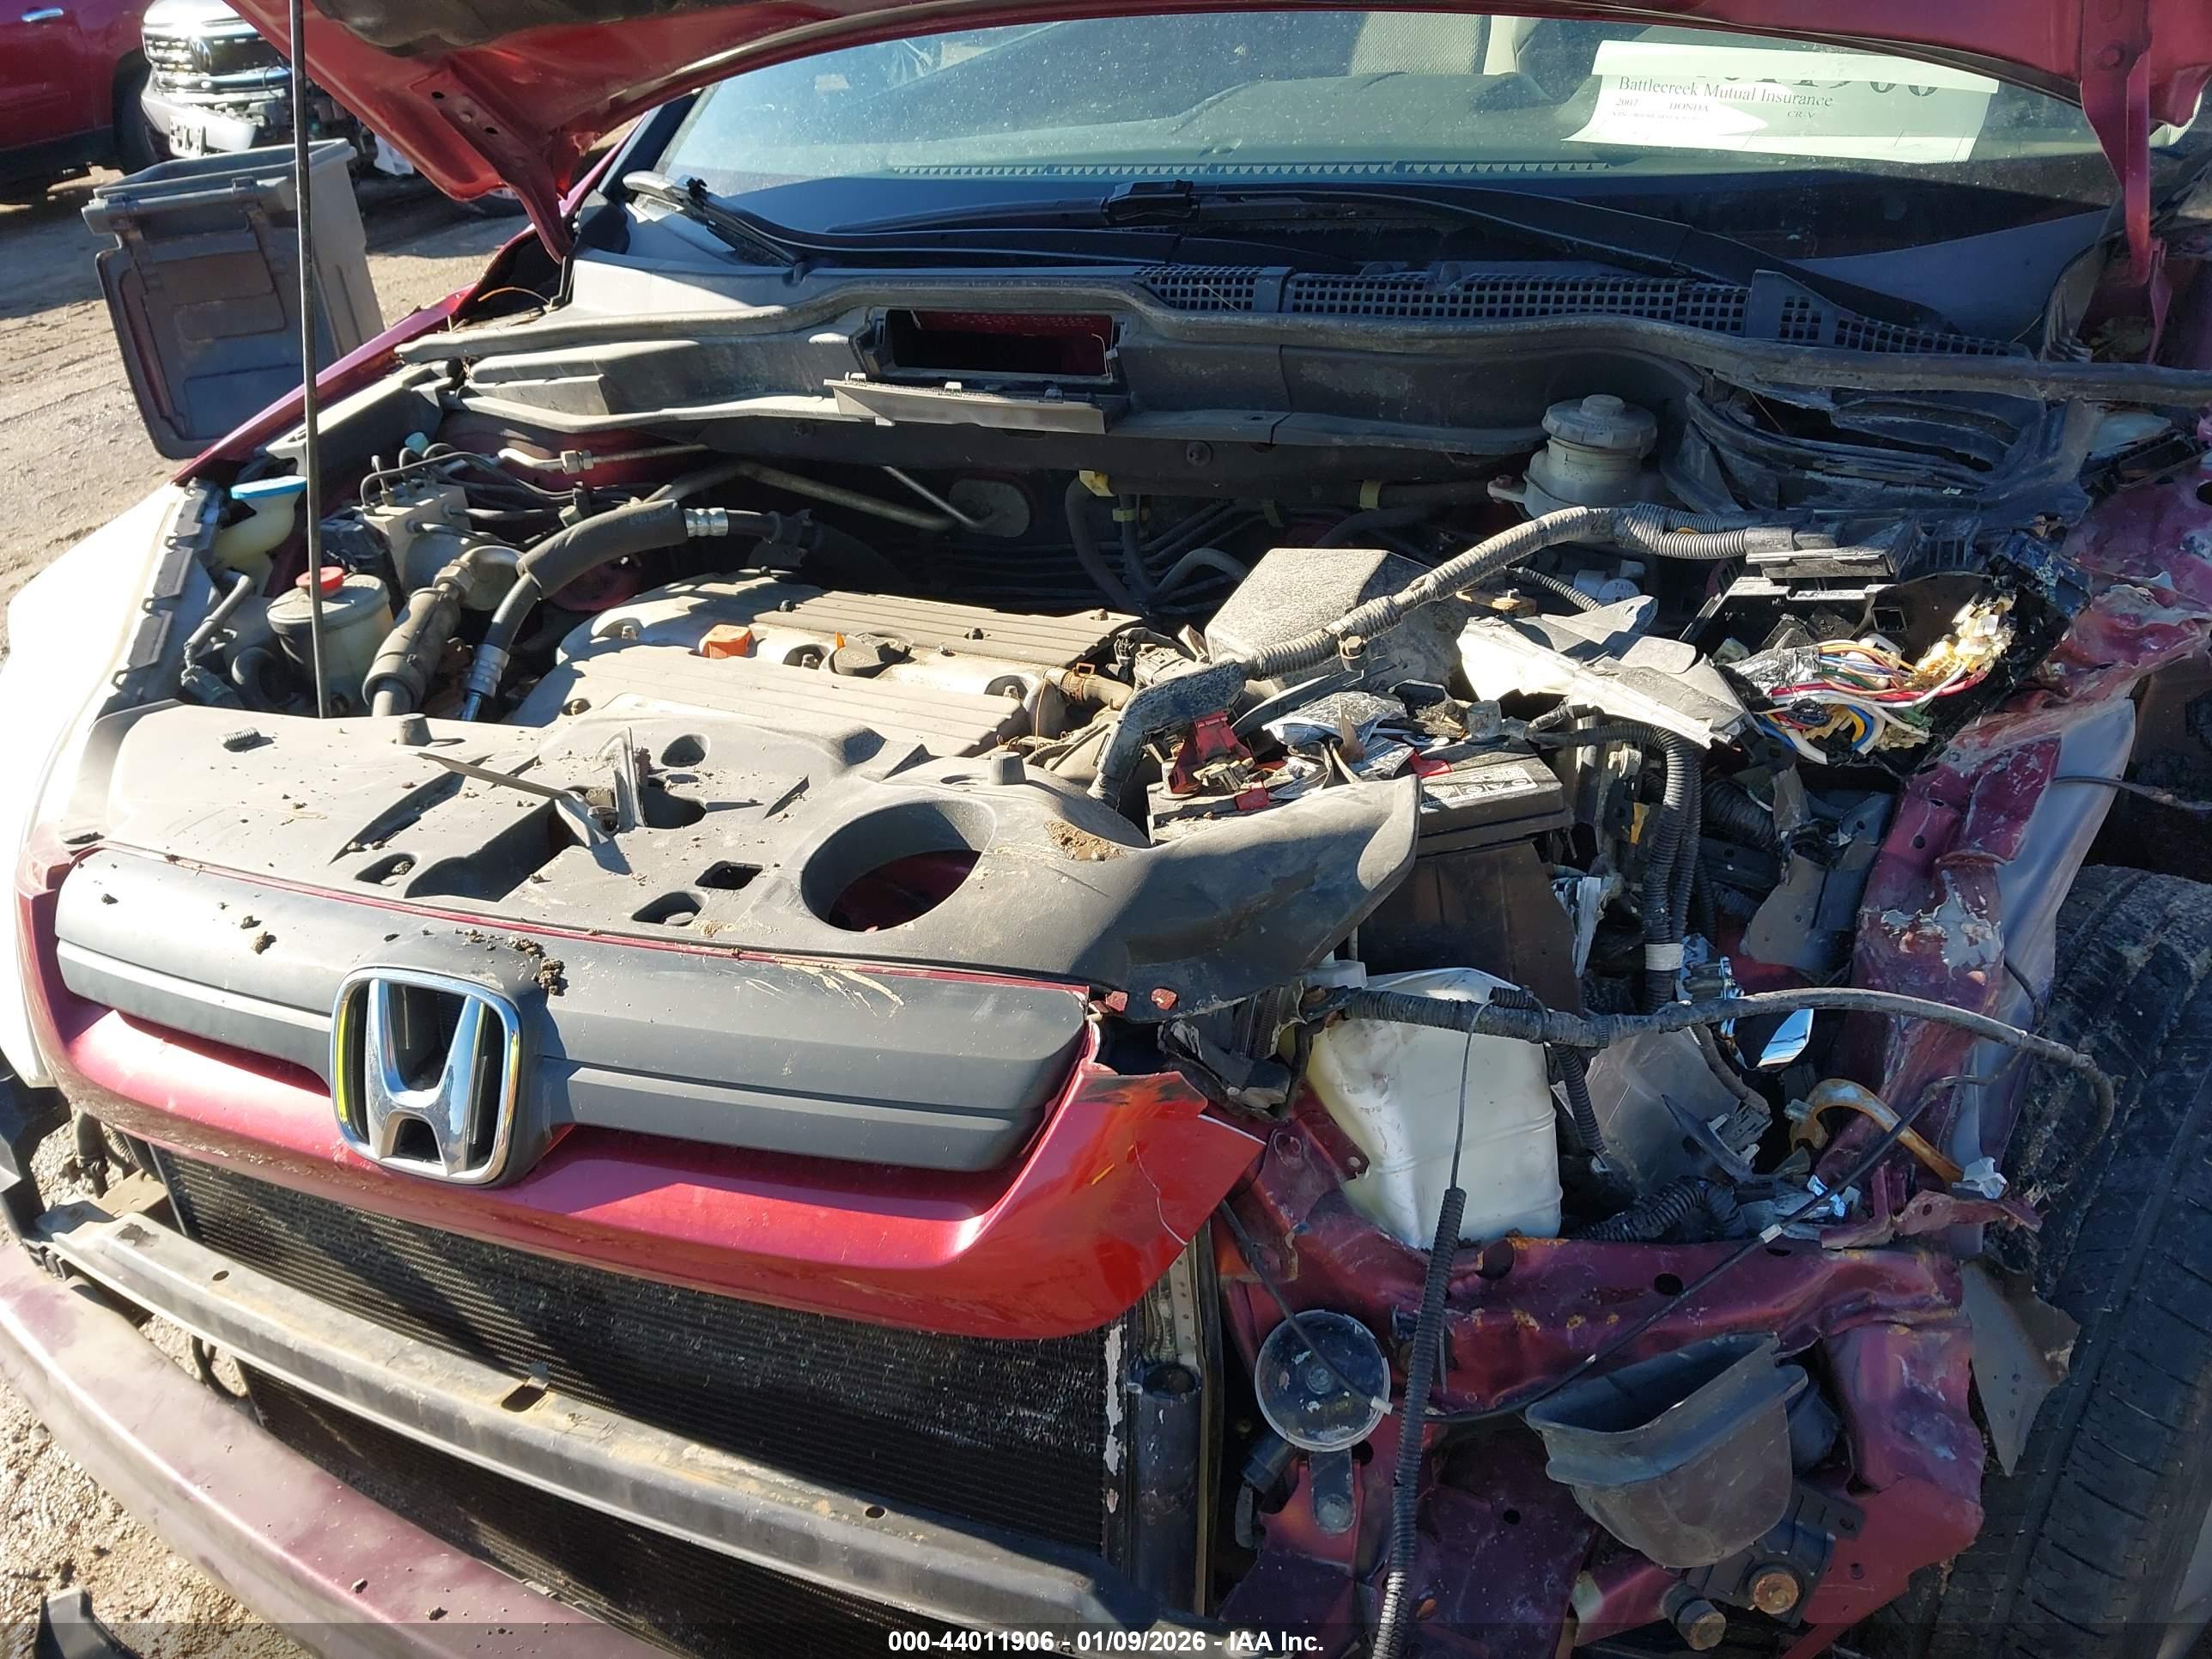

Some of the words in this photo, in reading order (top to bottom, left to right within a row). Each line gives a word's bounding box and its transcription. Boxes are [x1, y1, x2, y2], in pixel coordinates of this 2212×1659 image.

[1619, 76, 1699, 96] Battlecreek
[1704, 83, 1757, 101] Mutual
[1760, 88, 1834, 107] Insurance
